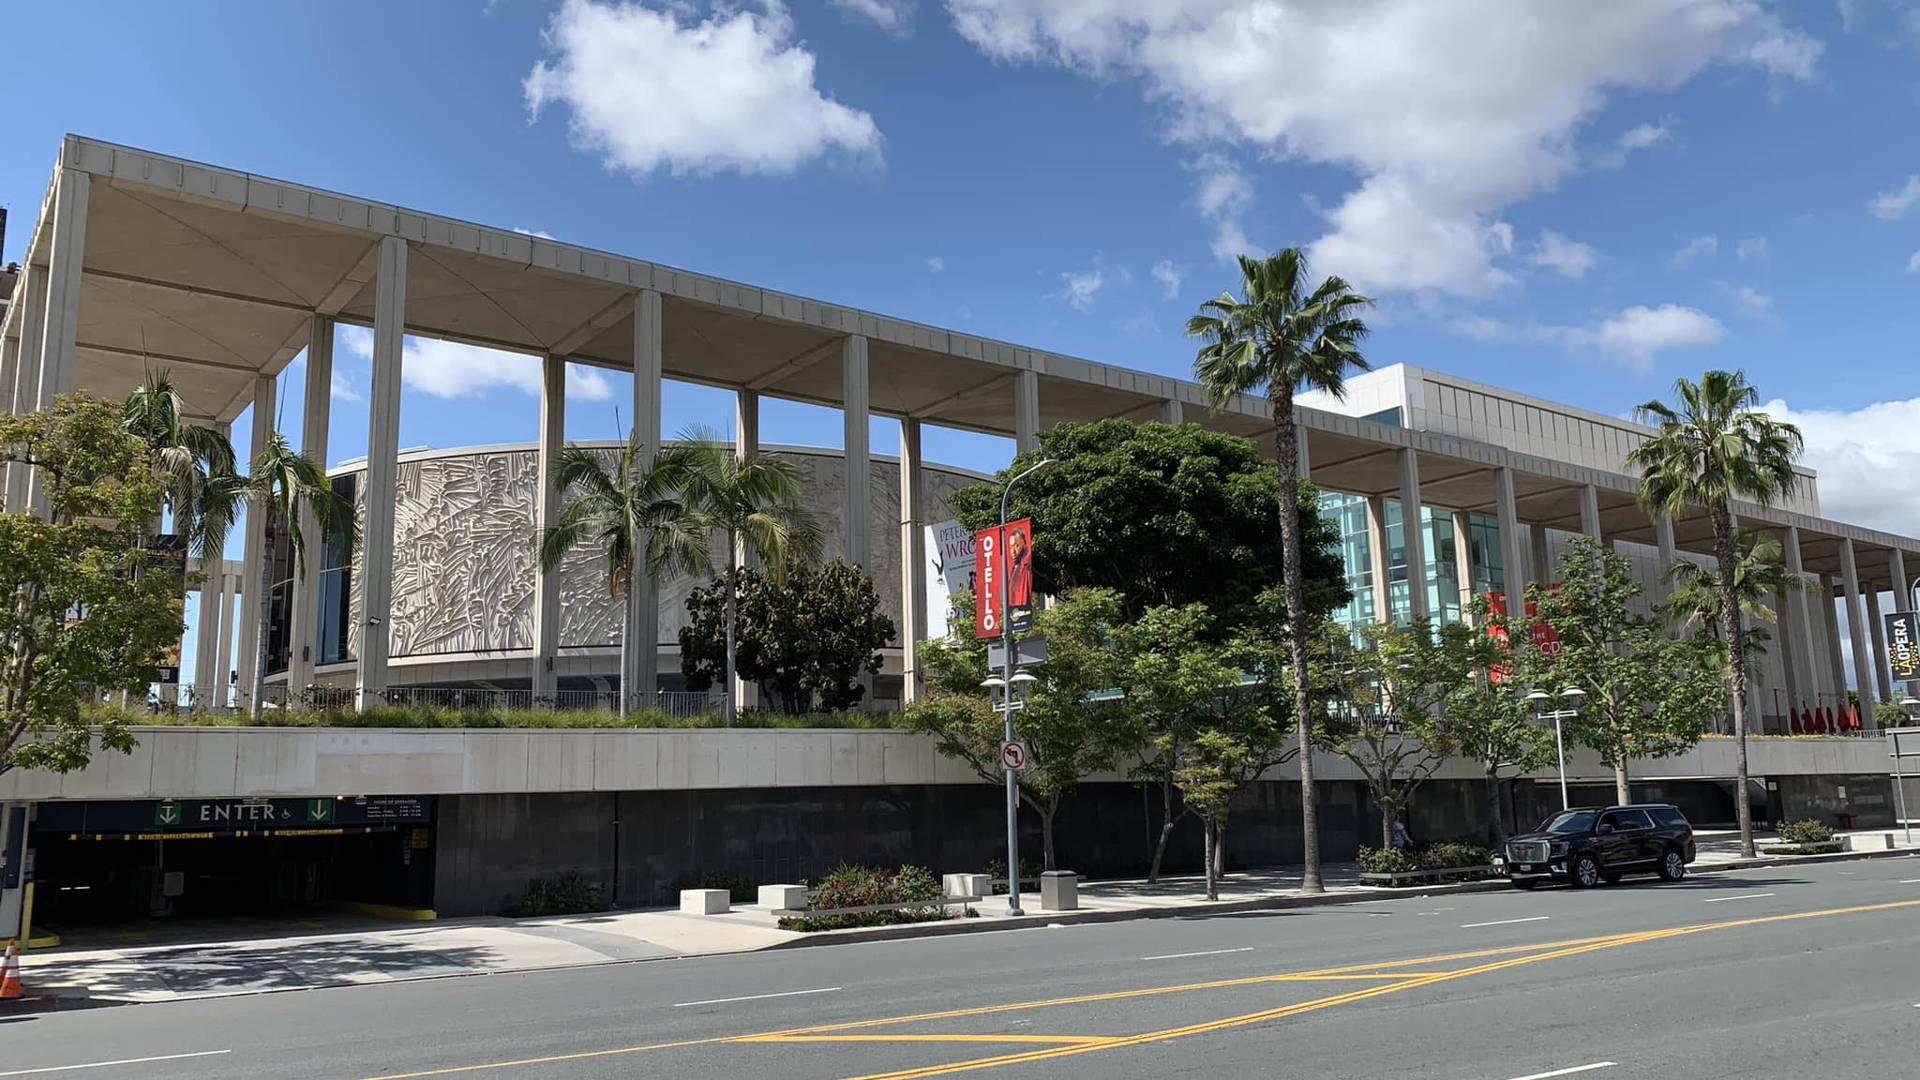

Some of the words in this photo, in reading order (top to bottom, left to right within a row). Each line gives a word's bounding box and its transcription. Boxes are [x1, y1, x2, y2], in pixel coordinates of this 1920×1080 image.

[940, 525, 967, 542] PETER
[983, 535, 994, 631] OTELLO
[200, 804, 275, 821] ENTER
